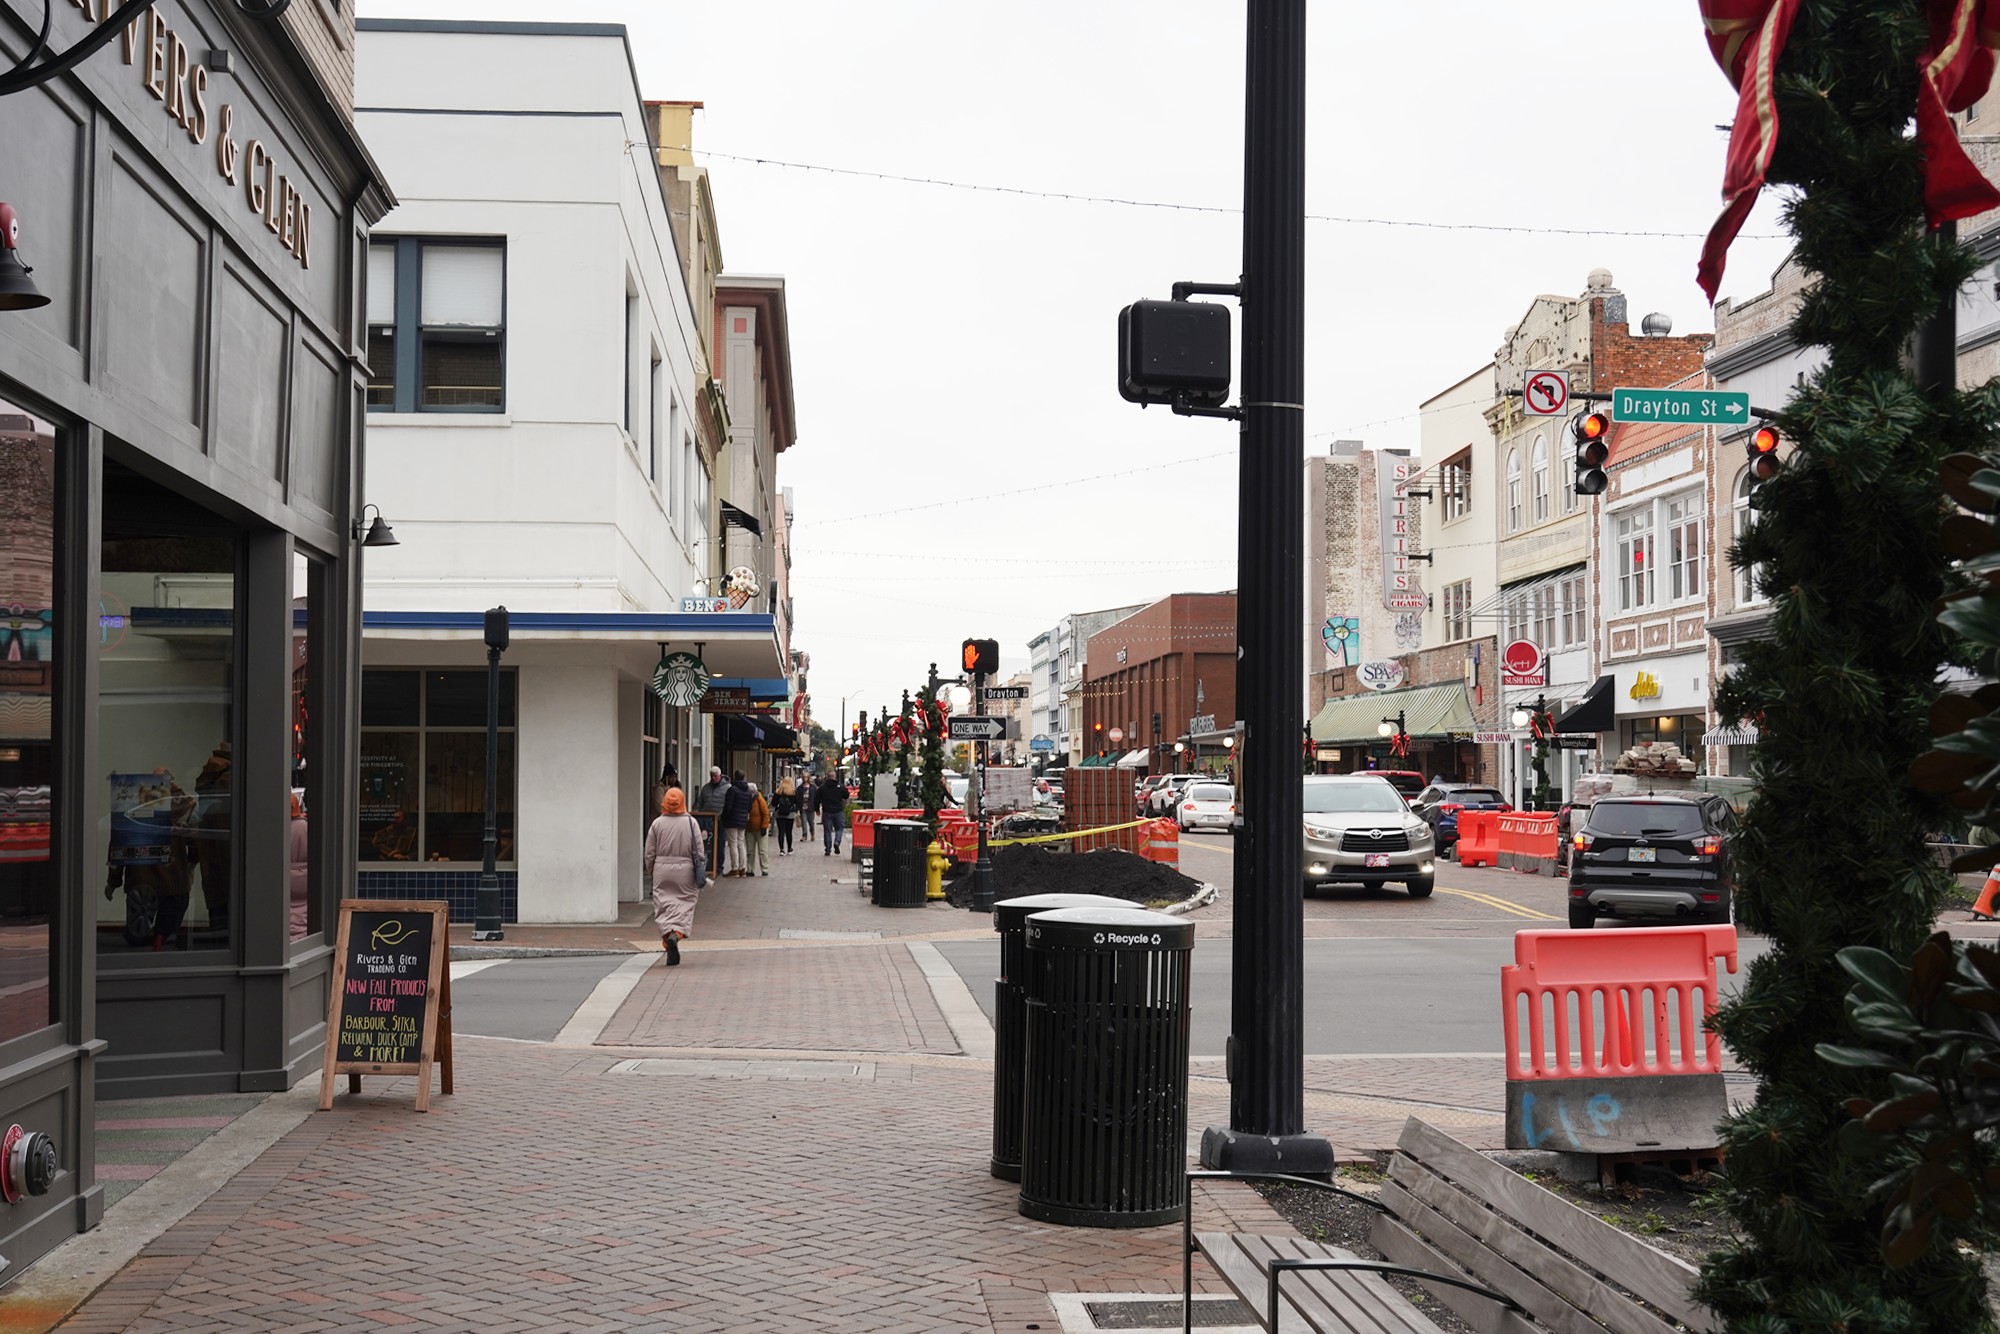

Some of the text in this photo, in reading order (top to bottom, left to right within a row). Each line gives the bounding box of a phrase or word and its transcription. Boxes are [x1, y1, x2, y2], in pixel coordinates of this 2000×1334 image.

[70, 0, 311, 270] VERS & GLEN
[1623, 396, 1717, 419] Drayton St
[684, 600, 715, 612] BEN
[1364, 666, 1391, 680] SPA
[1505, 676, 1541, 685] SUSHI HANA
[987, 689, 1019, 698] Drayton
[953, 724, 988, 733] ONE WAY
[1476, 734, 1494, 742] SUSHI
[1495, 733, 1511, 742] HANA
[1107, 933, 1149, 946] Recycle
[356, 953, 418, 966] Rivers & Glen
[367, 964, 396, 974] TRADING
[346, 979, 426, 996] NEW FALL PRODUCTS
[377, 1032, 398, 1047] DUCK
[399, 1033, 418, 1047] CAMP
[353, 1046, 405, 1063] & MORE!
